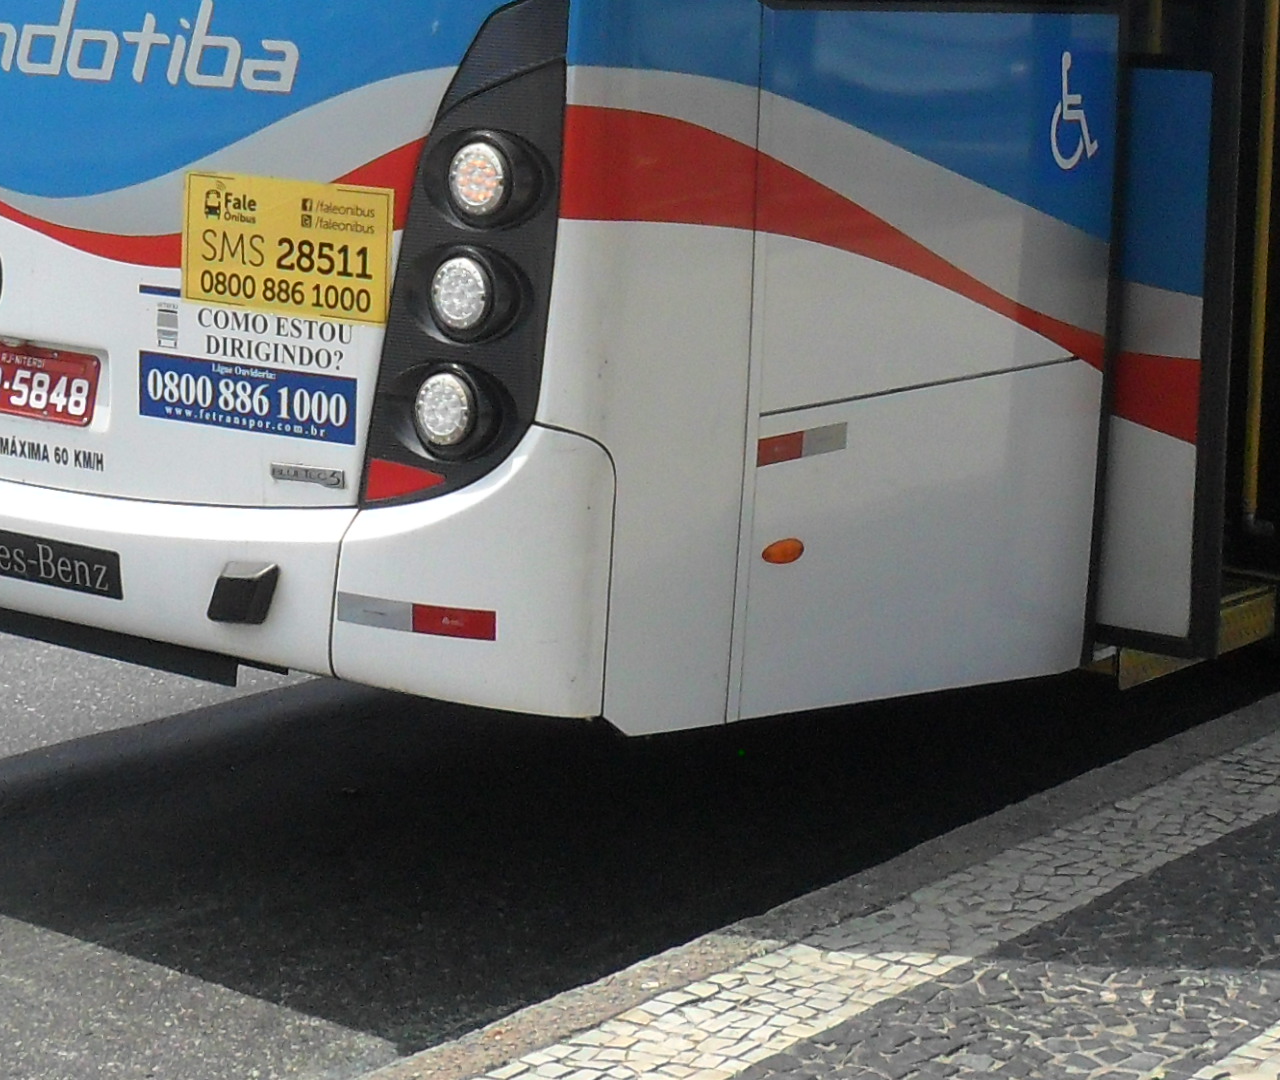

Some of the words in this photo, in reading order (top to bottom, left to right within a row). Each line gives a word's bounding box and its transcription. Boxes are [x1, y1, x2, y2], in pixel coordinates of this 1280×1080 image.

[224, 191, 257, 213] Fale
[201, 229, 265, 268] SMS
[276, 237, 373, 280] 28511
[200, 270, 256, 300] 0800
[262, 277, 305, 305] 886
[311, 283, 371, 313] 1000
[197, 307, 269, 335] COMO
[275, 316, 353, 345] ESTOU
[206, 334, 344, 370] DIRIGINDO?
[212, 362, 234, 376] Ligue
[147, 368, 213, 409] 0800
[218, 378, 270, 417] 886
[276, 386, 347, 427] 1000
[164, 405, 326, 438] www.fetranspor.com.br
[0, 435, 50, 463] MÁXIMA
[54, 448, 69, 465] 60
[74, 448, 105, 472] KM/H
